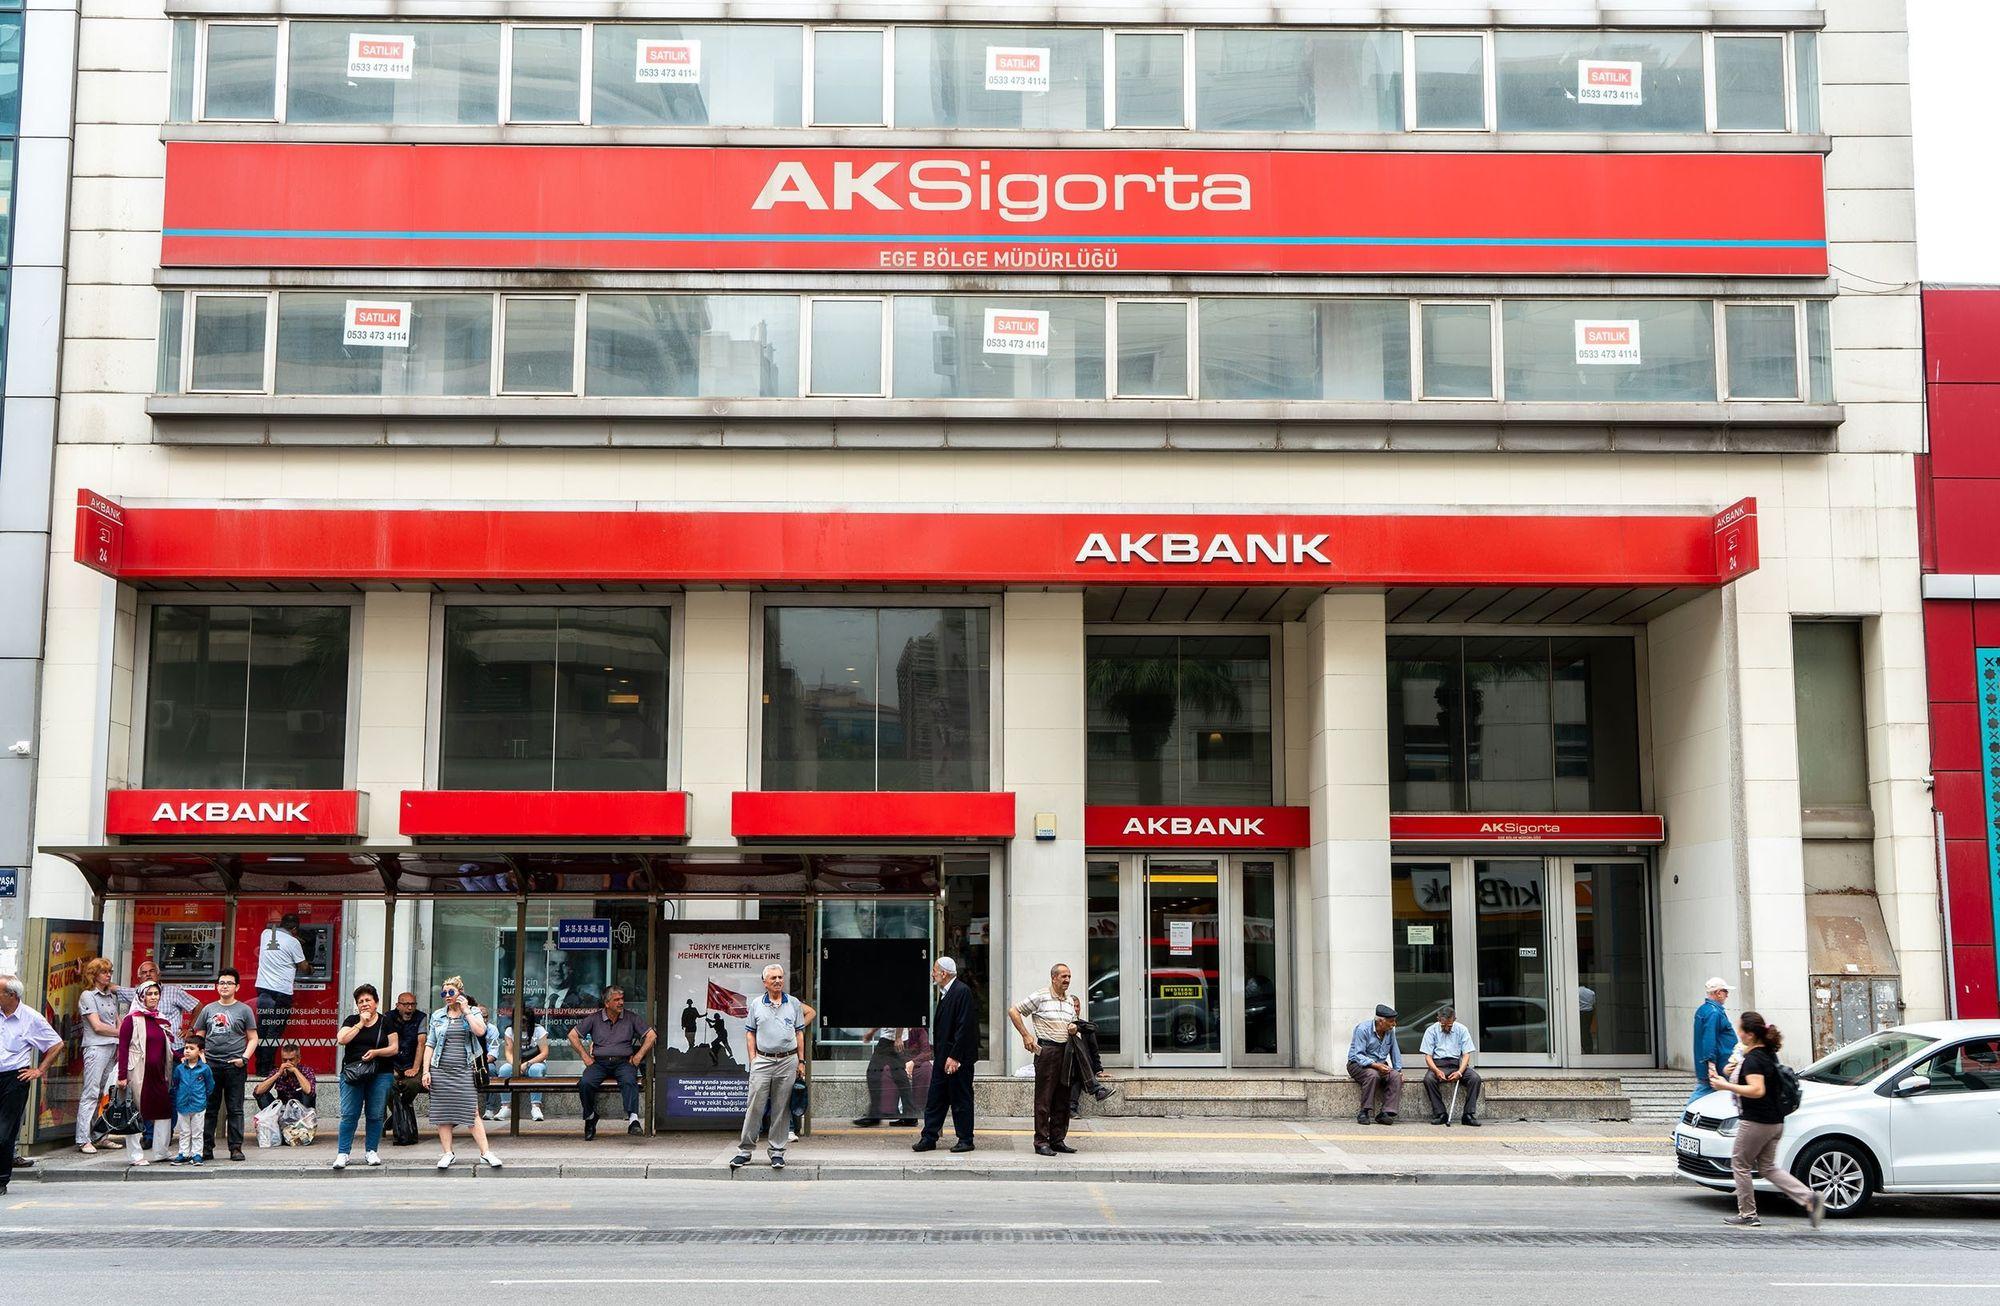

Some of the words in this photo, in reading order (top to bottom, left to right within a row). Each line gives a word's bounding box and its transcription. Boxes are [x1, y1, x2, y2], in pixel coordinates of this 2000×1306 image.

[362, 45, 401, 57] SATILIK
[649, 50, 688, 61] SATILIK
[350, 62, 371, 72] 0533
[373, 63, 388, 72] 473
[390, 64, 410, 73] 4114
[999, 57, 1038, 69] SATILIK
[638, 68, 659, 78] 0533
[661, 68, 676, 78] 473
[1591, 71, 1631, 82] SATILIK
[988, 76, 1008, 84] 0533
[1010, 76, 1026, 85] 473
[1028, 76, 1047, 86] 4114
[1581, 88, 1601, 98] 0533
[1602, 90, 1618, 99] 473
[1620, 90, 1639, 100] 4114
[751, 160, 1251, 222] AKSigorta
[879, 251, 918, 267] EGE
[923, 248, 988, 267] BÖLGE
[994, 248, 1118, 268] MÜDÜRLÜĞÜ
[358, 312, 398, 324] SATILIK
[998, 320, 1036, 332] SATILIK
[346, 330, 368, 340] 0533
[370, 331, 385, 340] 473
[386, 332, 407, 341] 4114
[1588, 330, 1626, 342] SATILIK
[986, 338, 1007, 348] 0533
[1008, 340, 1024, 348] 473
[1026, 340, 1046, 349] 4114
[1578, 350, 1599, 358] 0533
[1600, 350, 1616, 358] 473
[1618, 350, 1638, 358] 4114
[90, 497, 121, 520] AKBANK
[1716, 505, 1745, 528] AKBANK
[1075, 533, 1332, 563] AKBANK
[99, 547, 108, 563] 24
[1729, 554, 1737, 571] 24
[152, 802, 310, 822] AKBANK
[1122, 817, 1265, 835] AKBANK
[1480, 822, 1560, 834] AKSigorta
[722, 944, 770, 952] MEHMETÇİK'E
[678, 952, 720, 960] MEHMETÇİK
